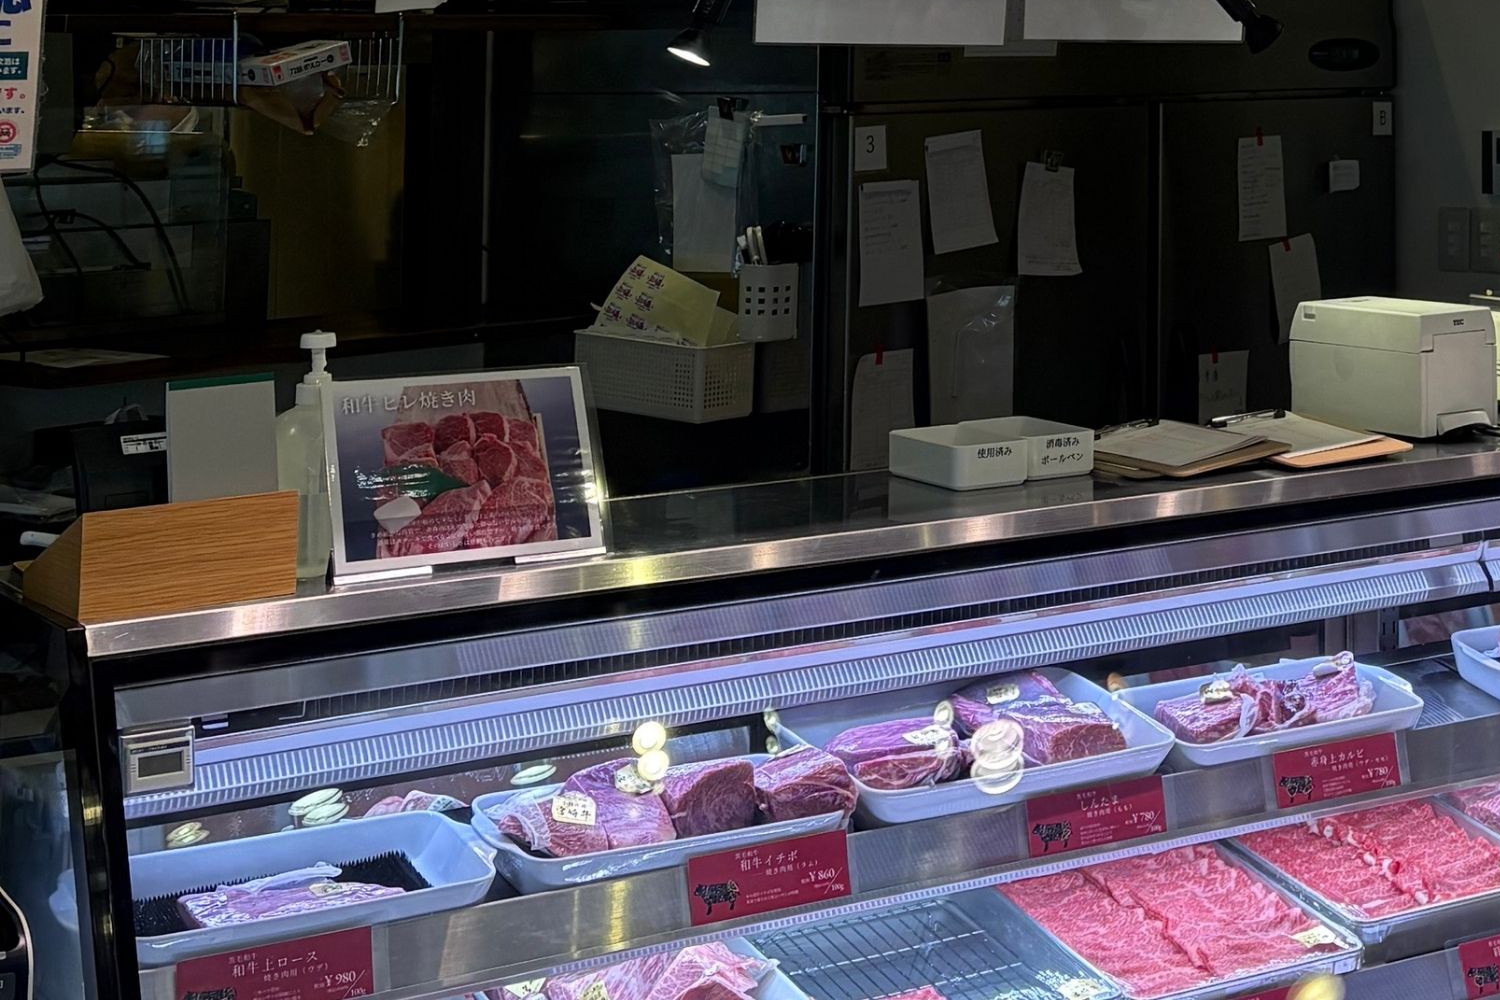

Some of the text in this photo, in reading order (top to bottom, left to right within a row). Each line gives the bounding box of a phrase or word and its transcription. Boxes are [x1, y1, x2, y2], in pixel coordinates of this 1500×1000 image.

[866, 135, 875, 153] 3
[977, 446, 1013, 460] 使用済み
[1041, 453, 1084, 465] ボールペン
[232, 951, 318, 979] 和牛上ロース
